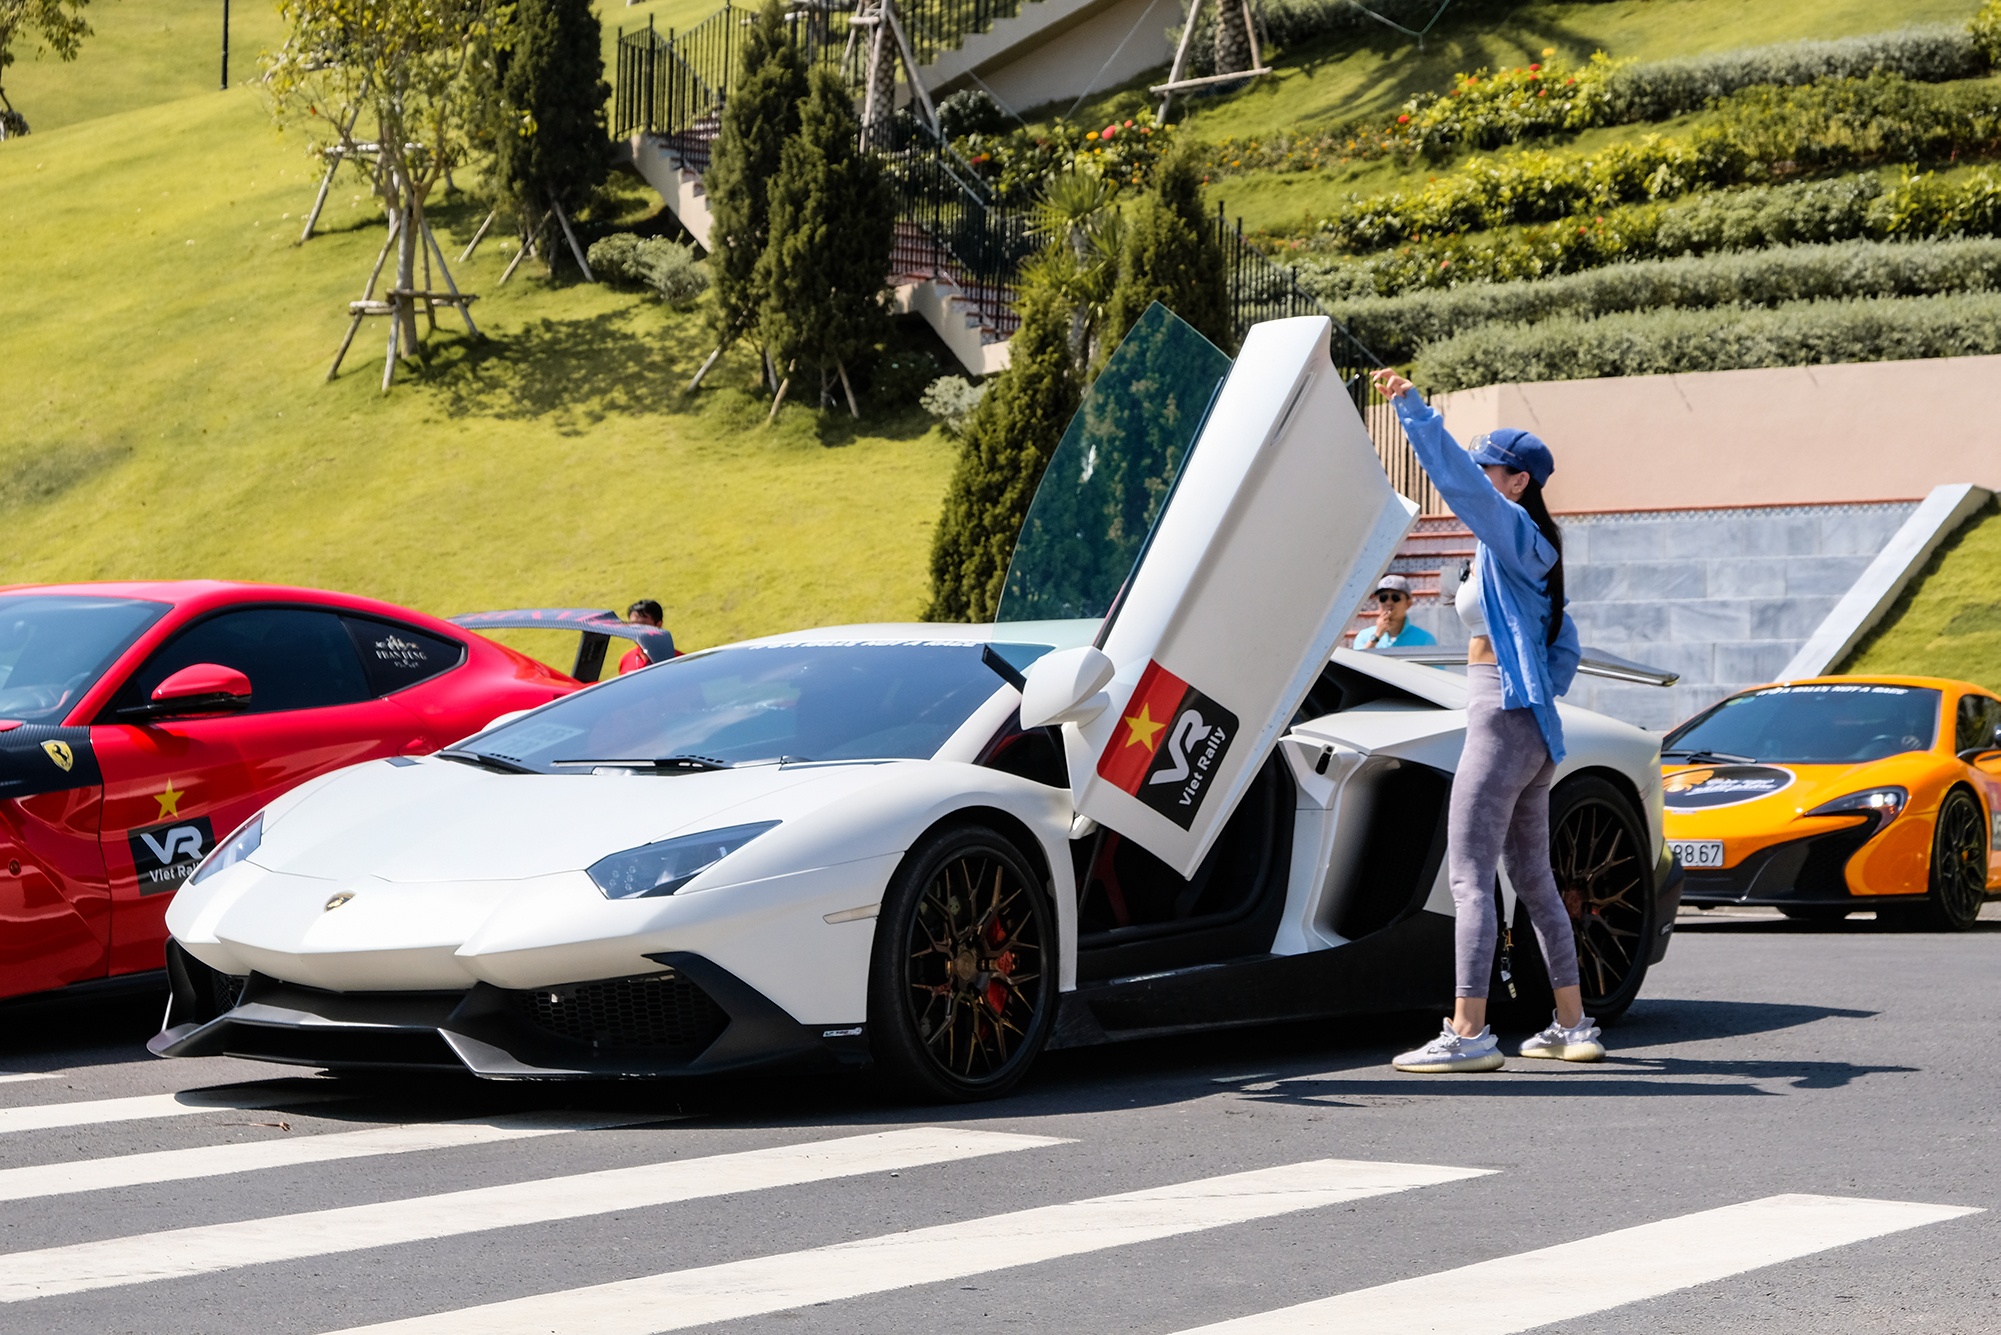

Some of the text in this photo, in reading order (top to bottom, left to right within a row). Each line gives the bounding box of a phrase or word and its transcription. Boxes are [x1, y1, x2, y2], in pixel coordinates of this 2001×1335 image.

[1148, 709, 1213, 785] VR
[1178, 726, 1227, 806] Viet Rally
[140, 825, 204, 865] VR
[148, 867, 176, 883] Viet
